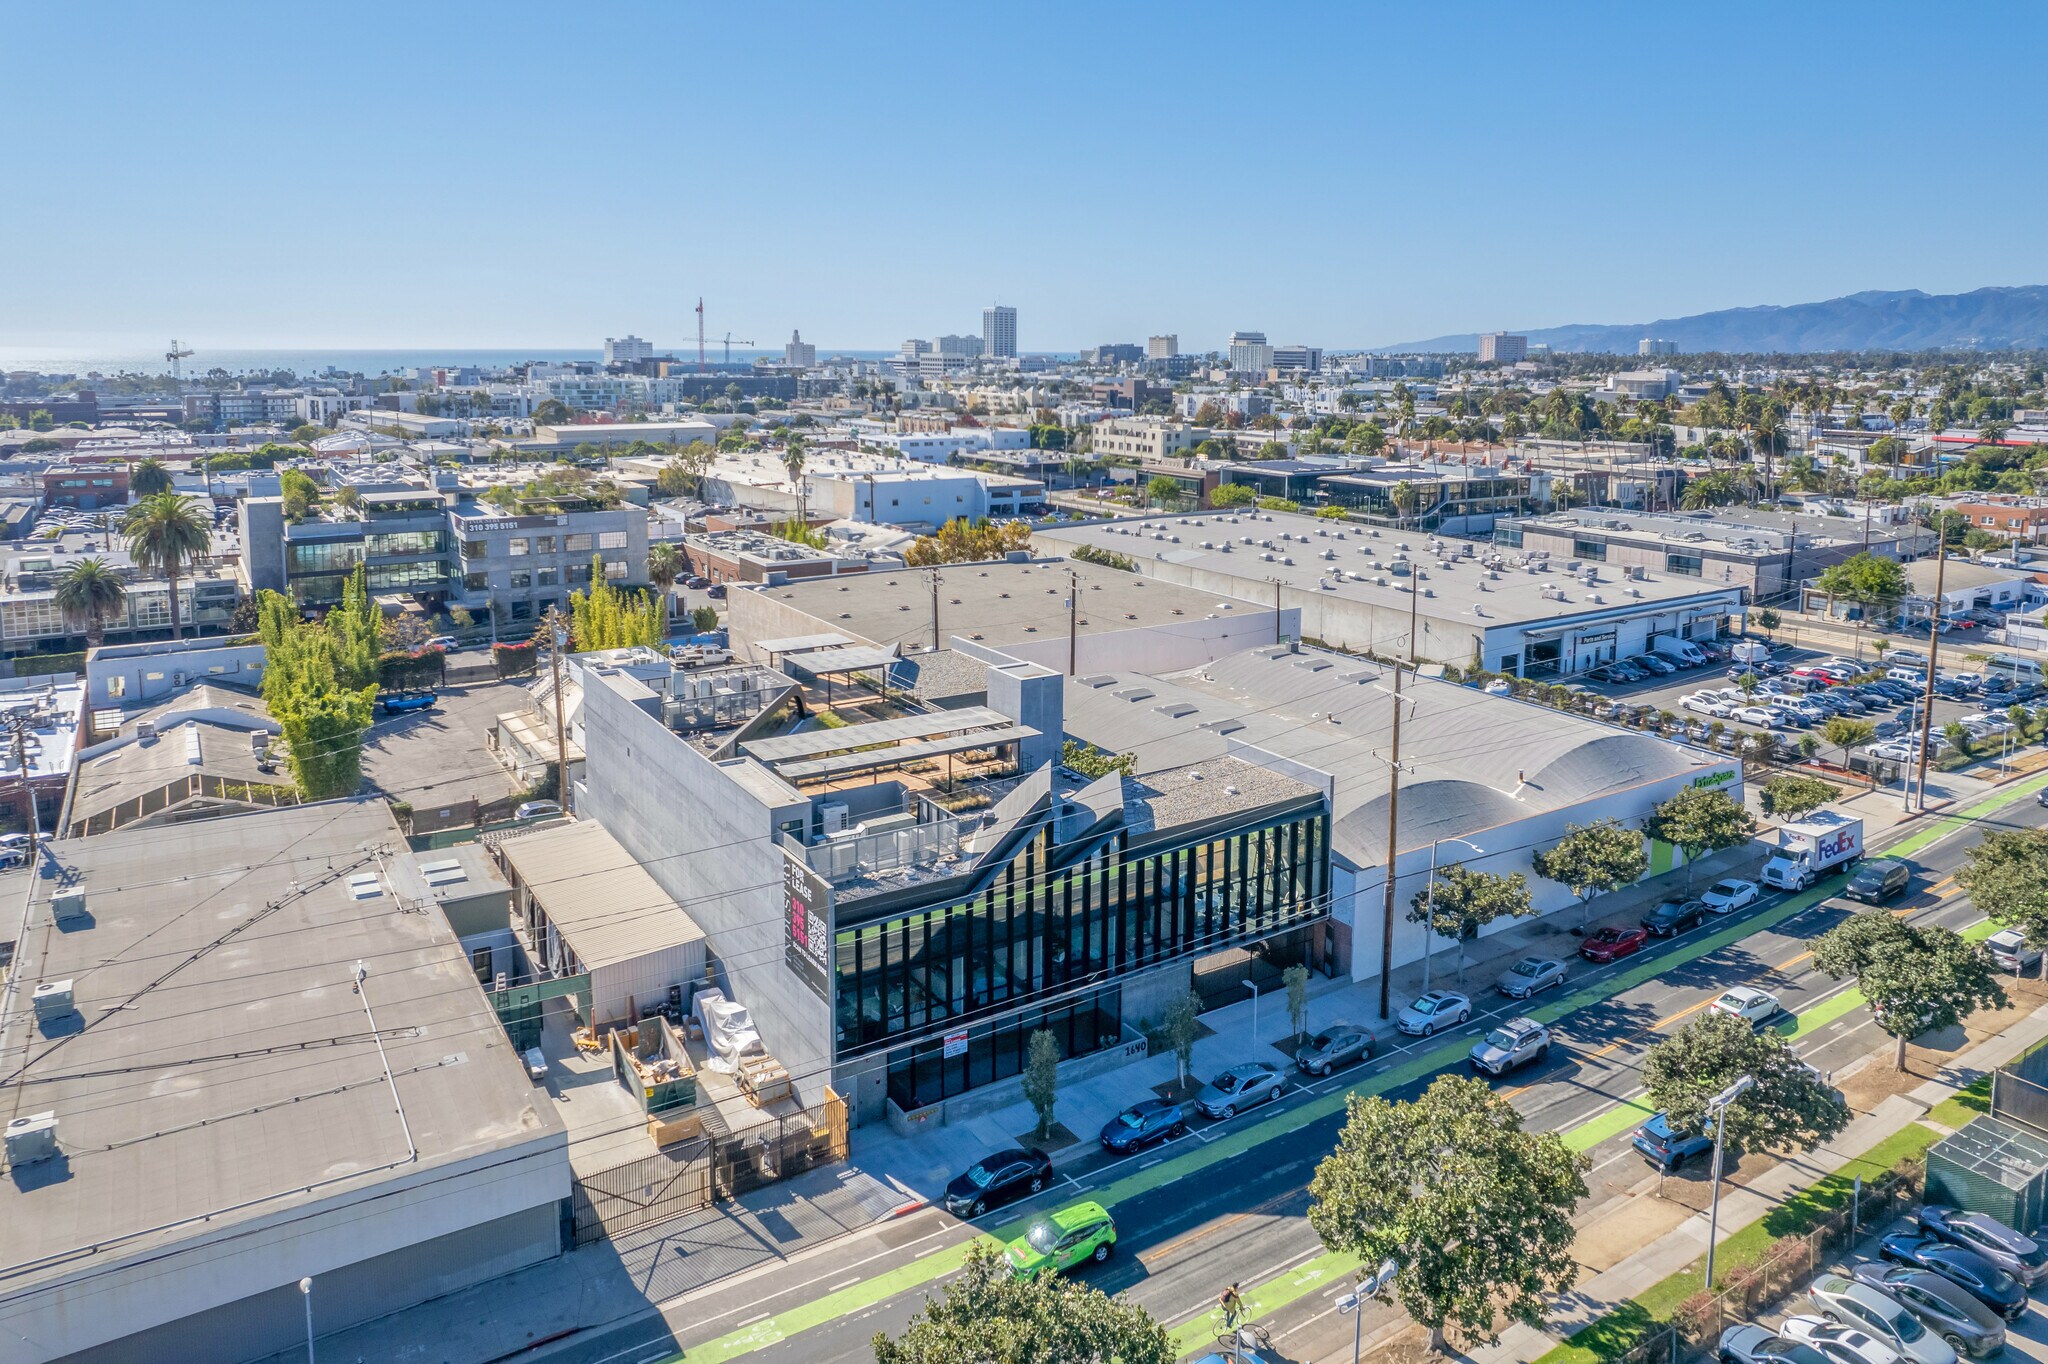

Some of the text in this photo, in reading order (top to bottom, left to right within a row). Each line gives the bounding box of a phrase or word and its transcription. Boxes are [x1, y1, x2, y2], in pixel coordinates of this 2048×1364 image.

[469, 524, 483, 532] 310
[484, 523, 499, 531] 395
[500, 521, 518, 530] 5151
[1789, 833, 1805, 842] FedEx
[1819, 831, 1854, 861] FedEx
[792, 863, 804, 883] FOR
[792, 876, 812, 902] LEASE
[792, 897, 804, 917] 310
[792, 911, 804, 931] 395
[792, 924, 808, 948] 5151
[1125, 1041, 1146, 1056] 1640
